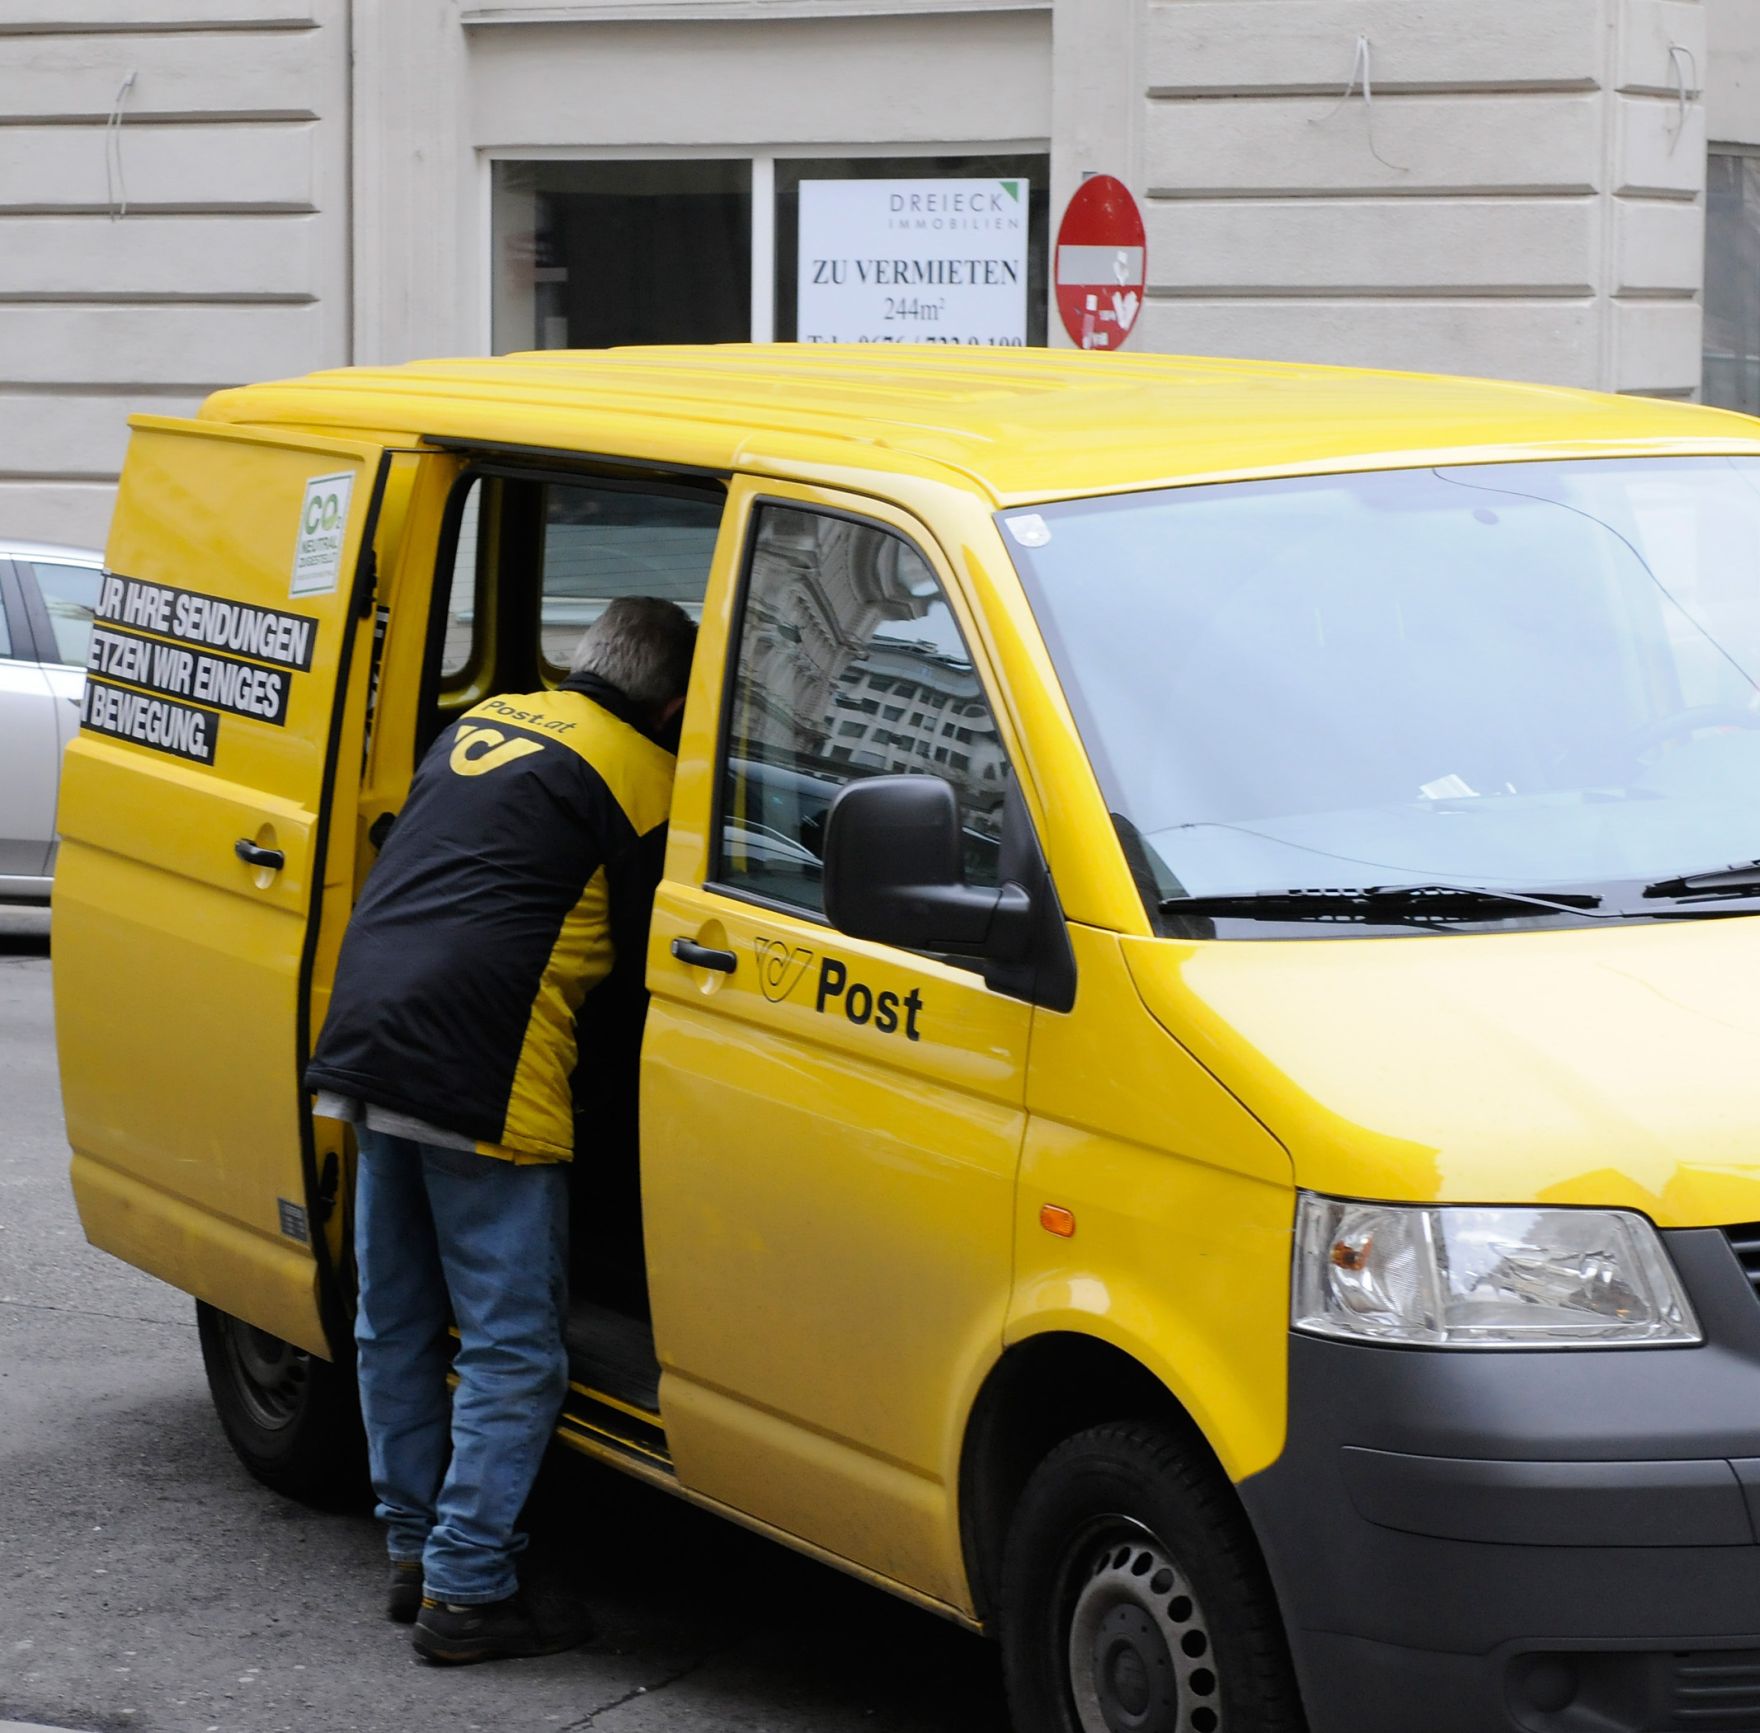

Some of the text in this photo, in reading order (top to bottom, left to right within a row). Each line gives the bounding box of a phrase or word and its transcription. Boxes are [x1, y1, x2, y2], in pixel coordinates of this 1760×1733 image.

[888, 218, 1020, 230] IMMOBILIEN
[890, 193, 1004, 213] DREIECK
[812, 260, 1019, 285] ZU VERMIETEN
[123, 581, 175, 632] IHRE
[173, 593, 309, 666] SENDUNGEN
[152, 645, 194, 697] WIR
[193, 657, 282, 719] EINIGES
[90, 686, 210, 759] BEWEGUNG.
[481, 700, 578, 734] Post.at
[816, 957, 923, 1042] Post
